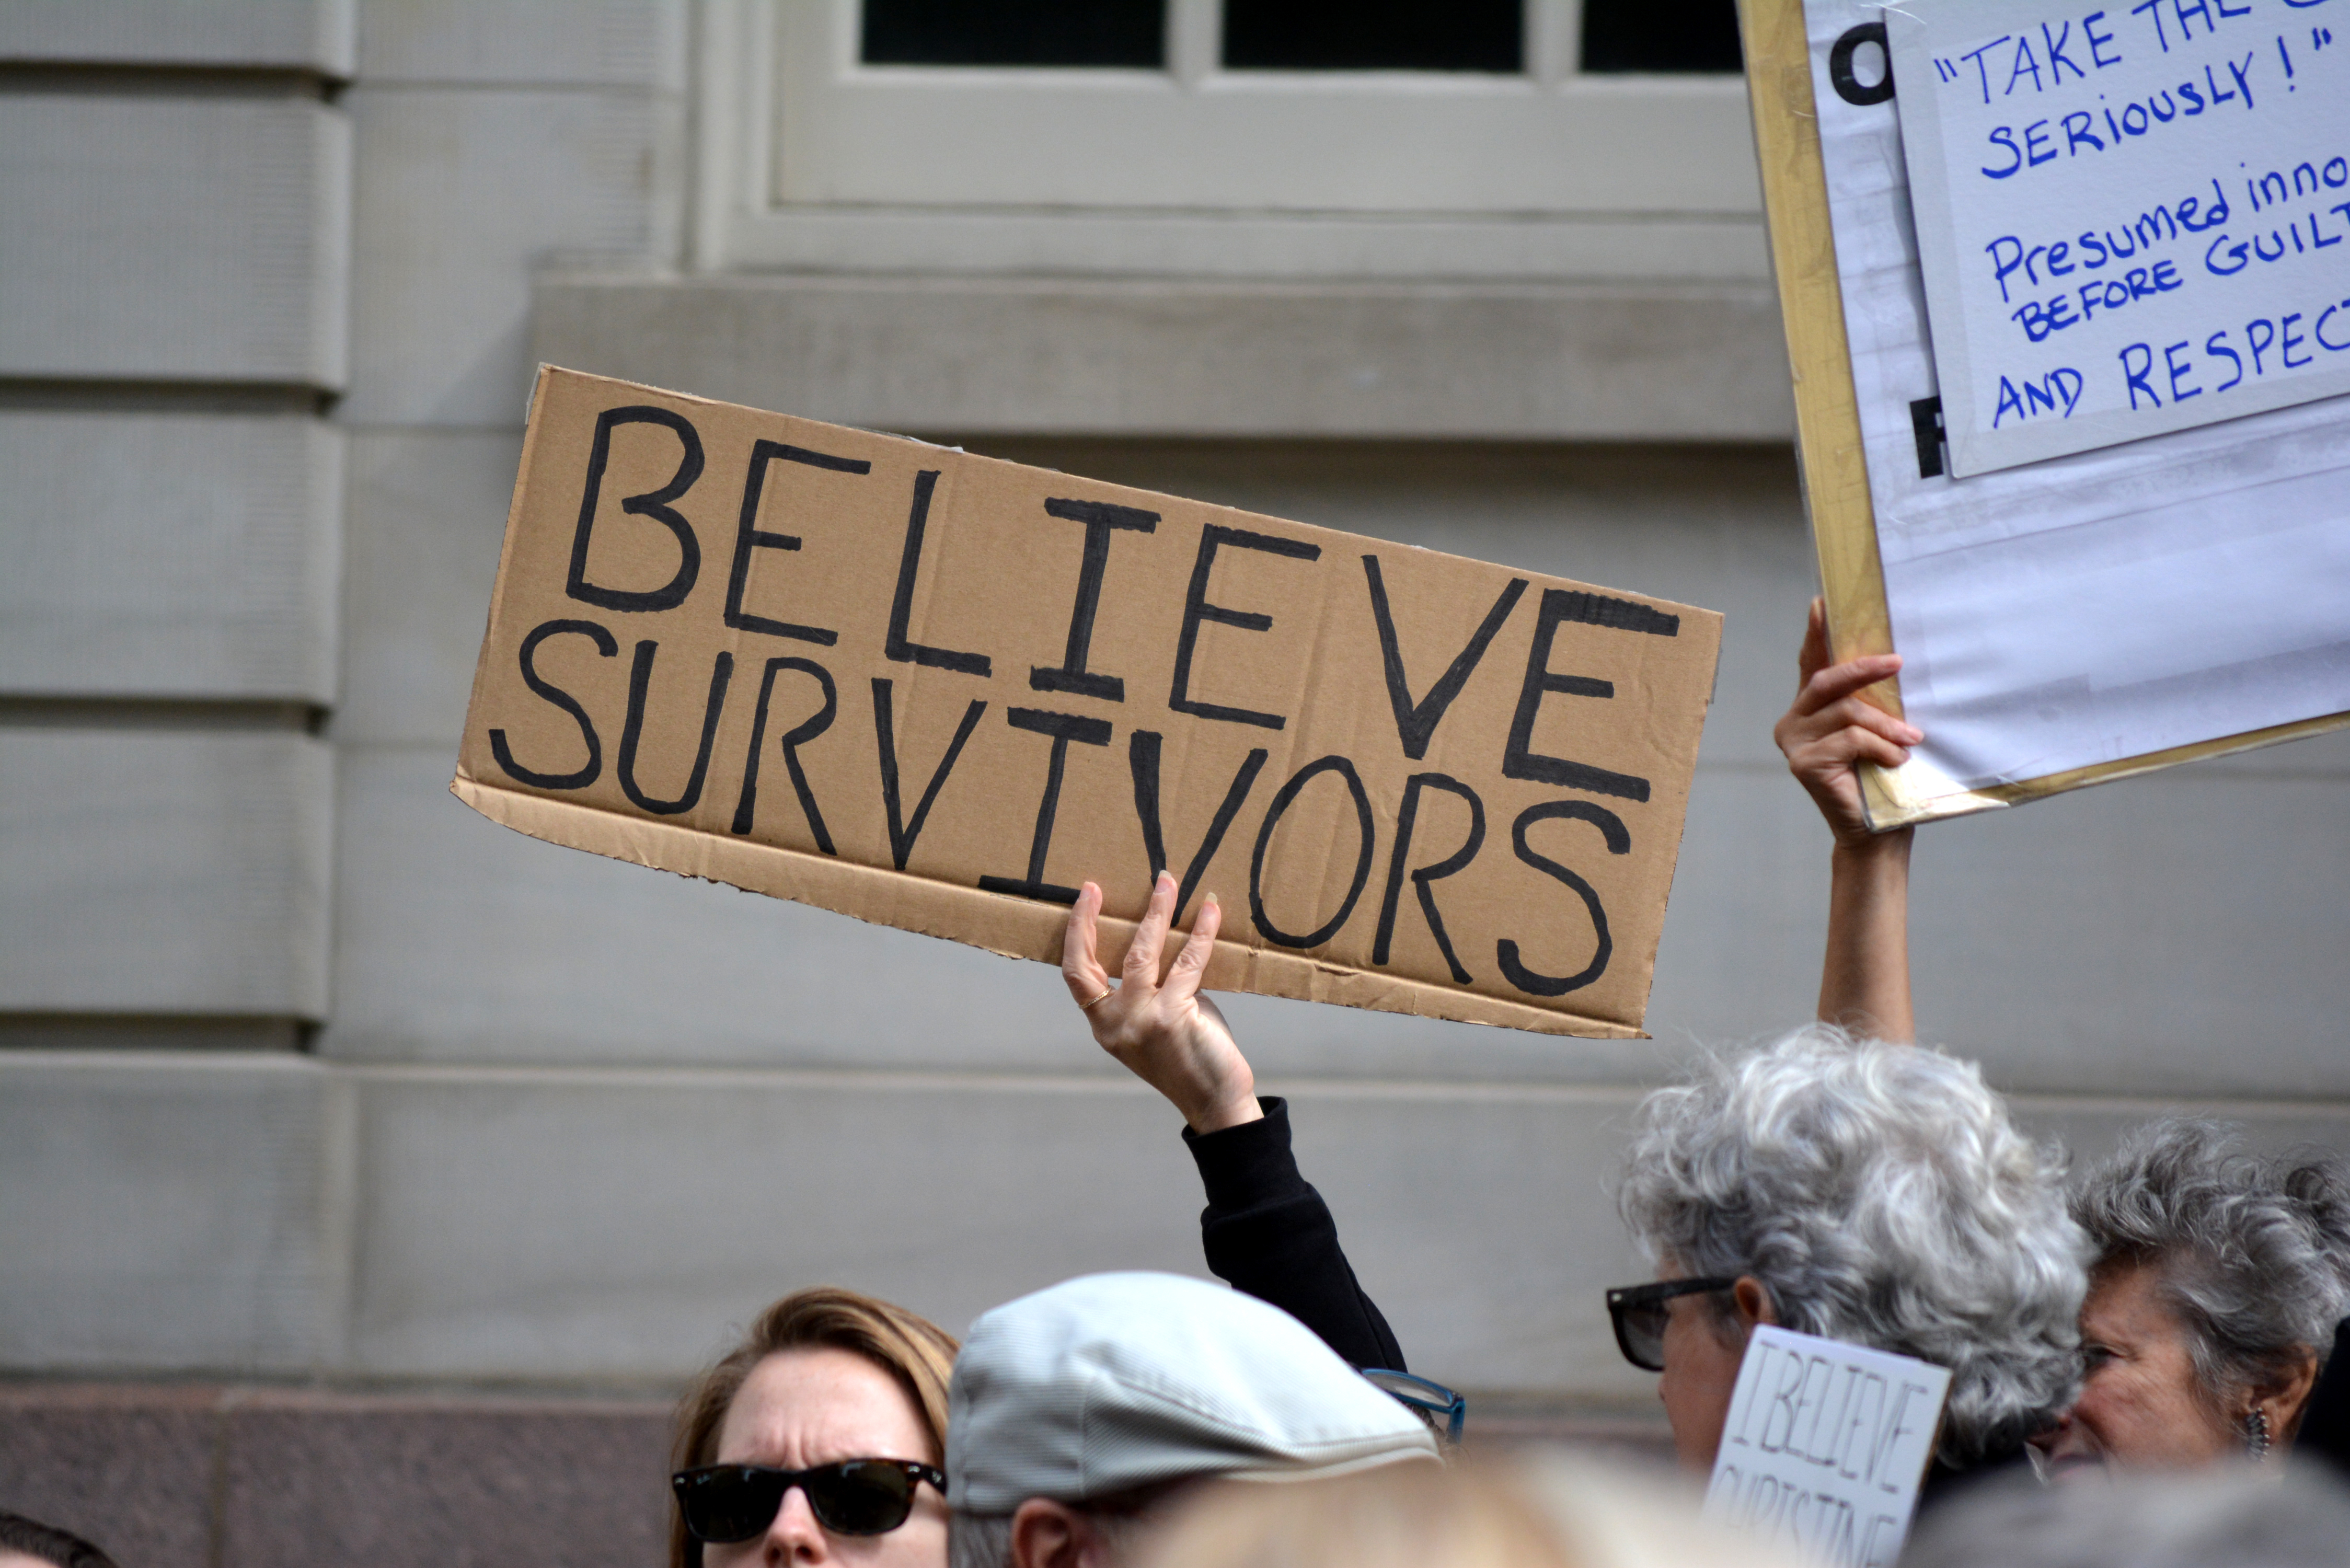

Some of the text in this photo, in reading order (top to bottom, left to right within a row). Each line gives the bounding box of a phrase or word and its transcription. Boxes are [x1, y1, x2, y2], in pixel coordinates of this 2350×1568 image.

[1985, 178, 2229, 302] Presumed
[2011, 259, 2184, 342] BEFORE
[1992, 367, 2084, 429] AND
[566, 405, 1680, 802] BELIEVE
[488, 618, 1630, 996] SURVIVORS
[1759, 1350, 1929, 1495] BELIEVE
